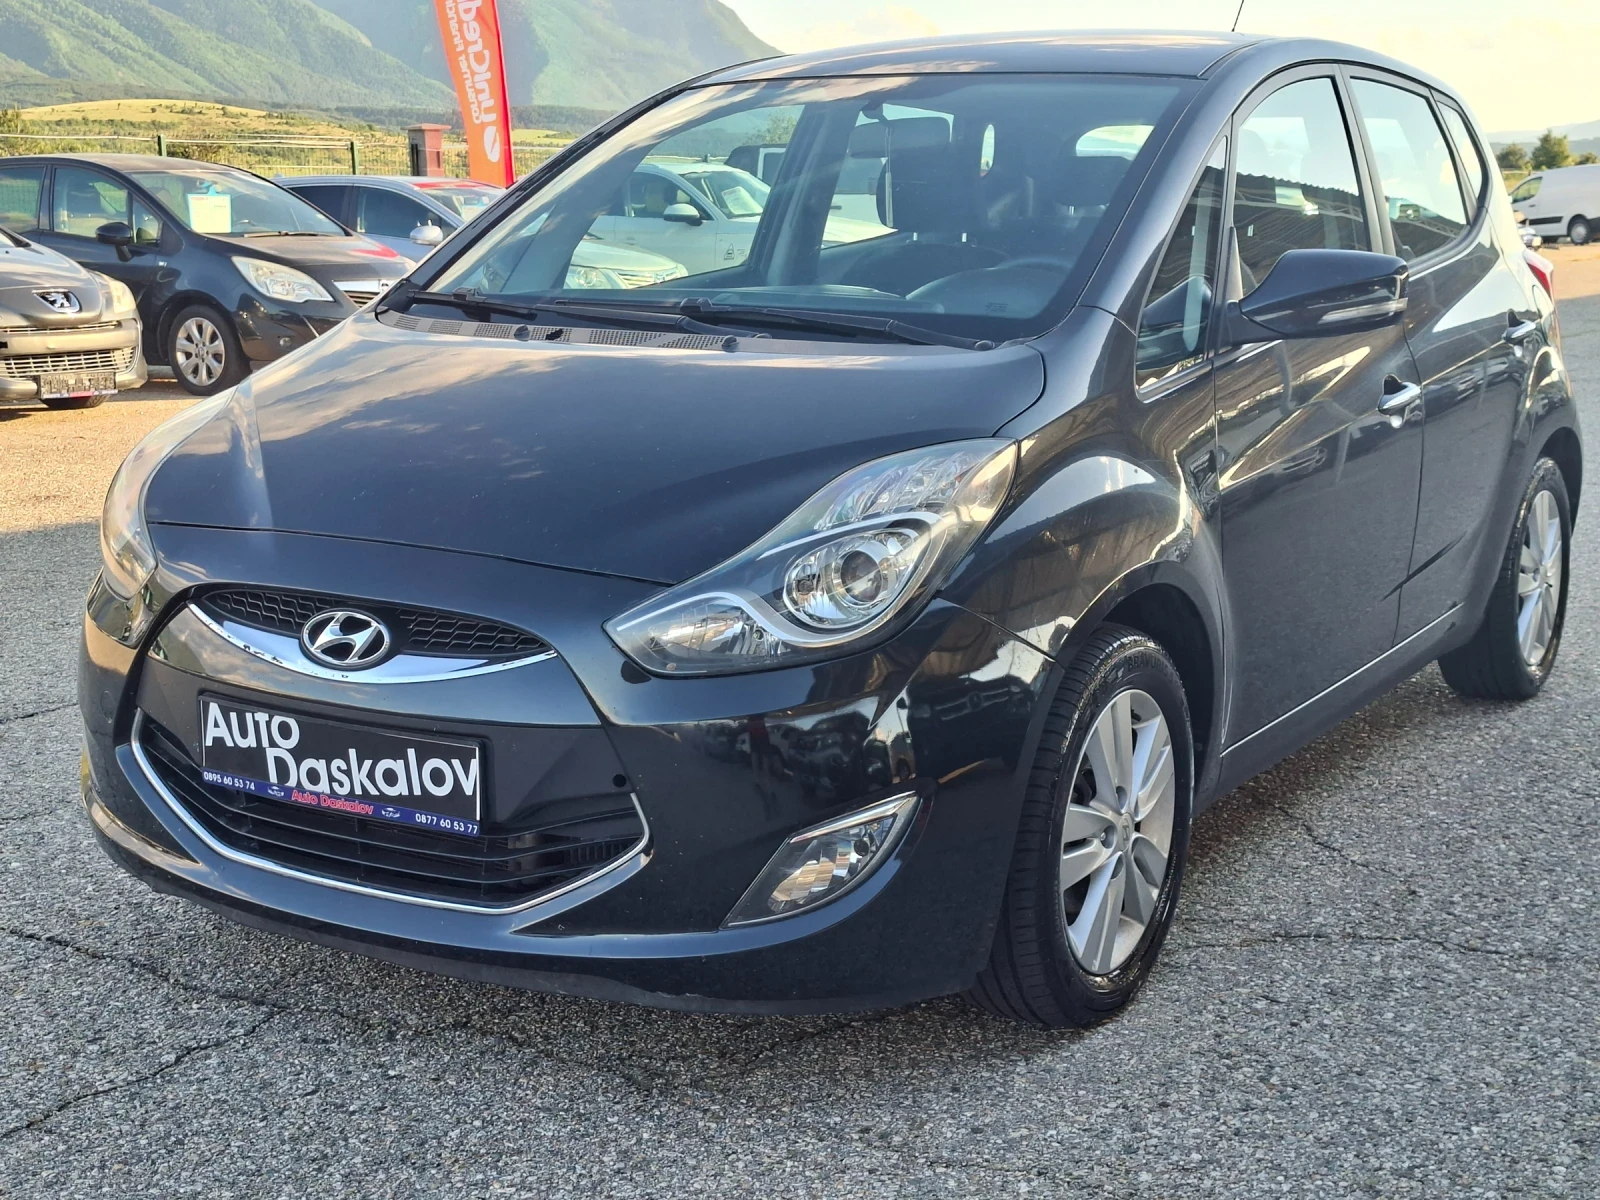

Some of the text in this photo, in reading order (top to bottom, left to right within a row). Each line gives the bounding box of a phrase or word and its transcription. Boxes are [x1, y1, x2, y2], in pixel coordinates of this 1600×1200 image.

[205, 702, 300, 750] Auto
[203, 771, 256, 791] 0895 60 53 74
[265, 747, 478, 797] Daskalov
[291, 789, 374, 815] Auto Daskalov
[415, 813, 478, 835] 0877 60 53 77
